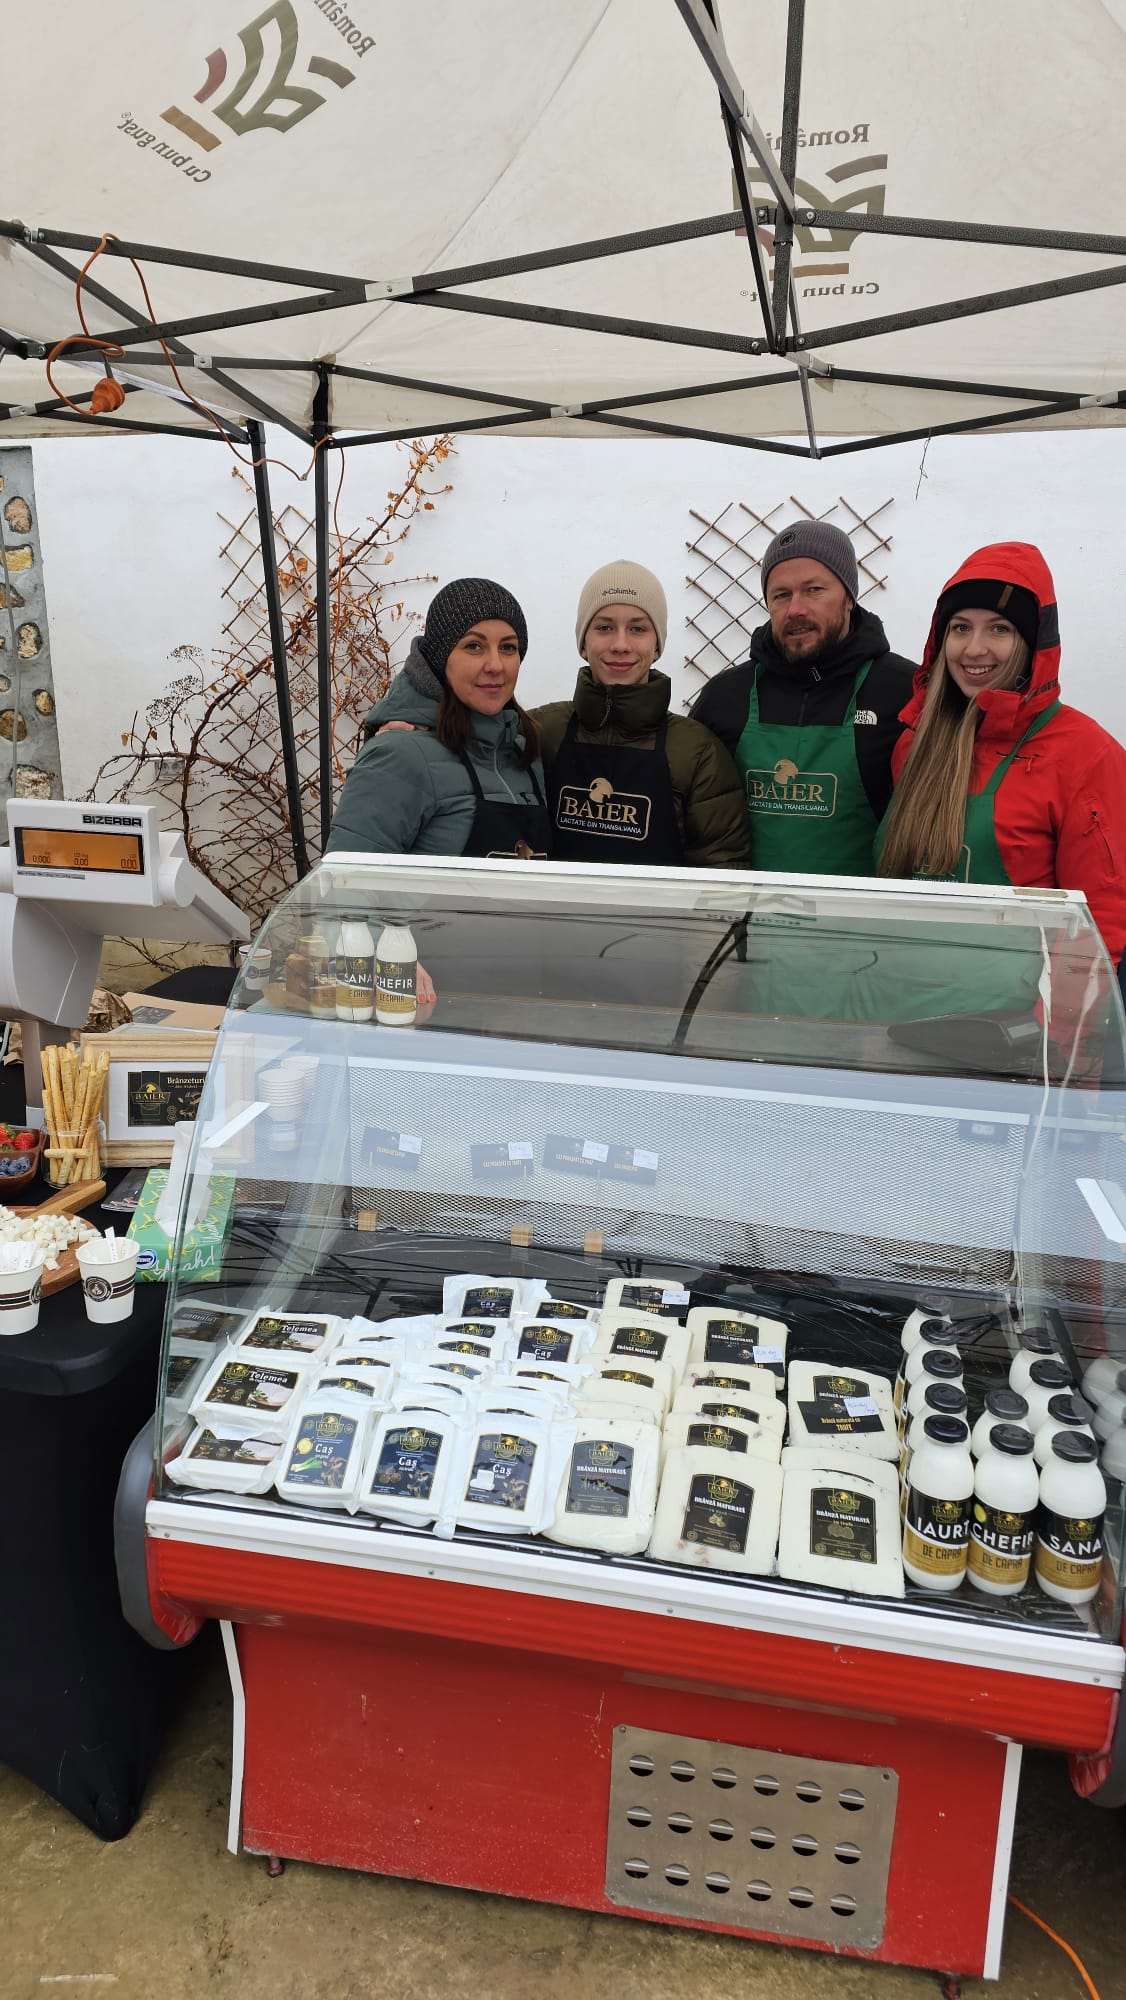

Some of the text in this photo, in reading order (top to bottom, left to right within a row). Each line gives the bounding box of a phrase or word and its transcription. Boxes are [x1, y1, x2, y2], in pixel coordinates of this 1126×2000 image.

[750, 779, 825, 803] BAIER
[561, 796, 639, 825] BAIER
[772, 802, 783, 810] DIN
[783, 803, 829, 812] TRANSILVANIA
[82, 814, 142, 827] BIZERBA
[560, 816, 642, 835] LACTATE DIN TRANSILVANIA
[344, 973, 373, 984] SANA
[376, 976, 413, 989] CHEFIR
[281, 1325, 318, 1333] Telemea
[249, 1371, 288, 1384] Telemea
[315, 1443, 334, 1455] Caș
[398, 1456, 418, 1468] Caș
[492, 1463, 513, 1477] Caș
[576, 1465, 627, 1476] BRÂNZĂ MATURATĂ
[694, 1496, 746, 1514] BRÂNZĂ MATURATĂ
[917, 1516, 970, 1539] IAURT
[972, 1522, 1034, 1550] CHEFIR
[922, 1544, 933, 1558] DE
[1049, 1534, 1102, 1556] SANA
[982, 1552, 993, 1566] DE
[1056, 1560, 1069, 1573] DE
